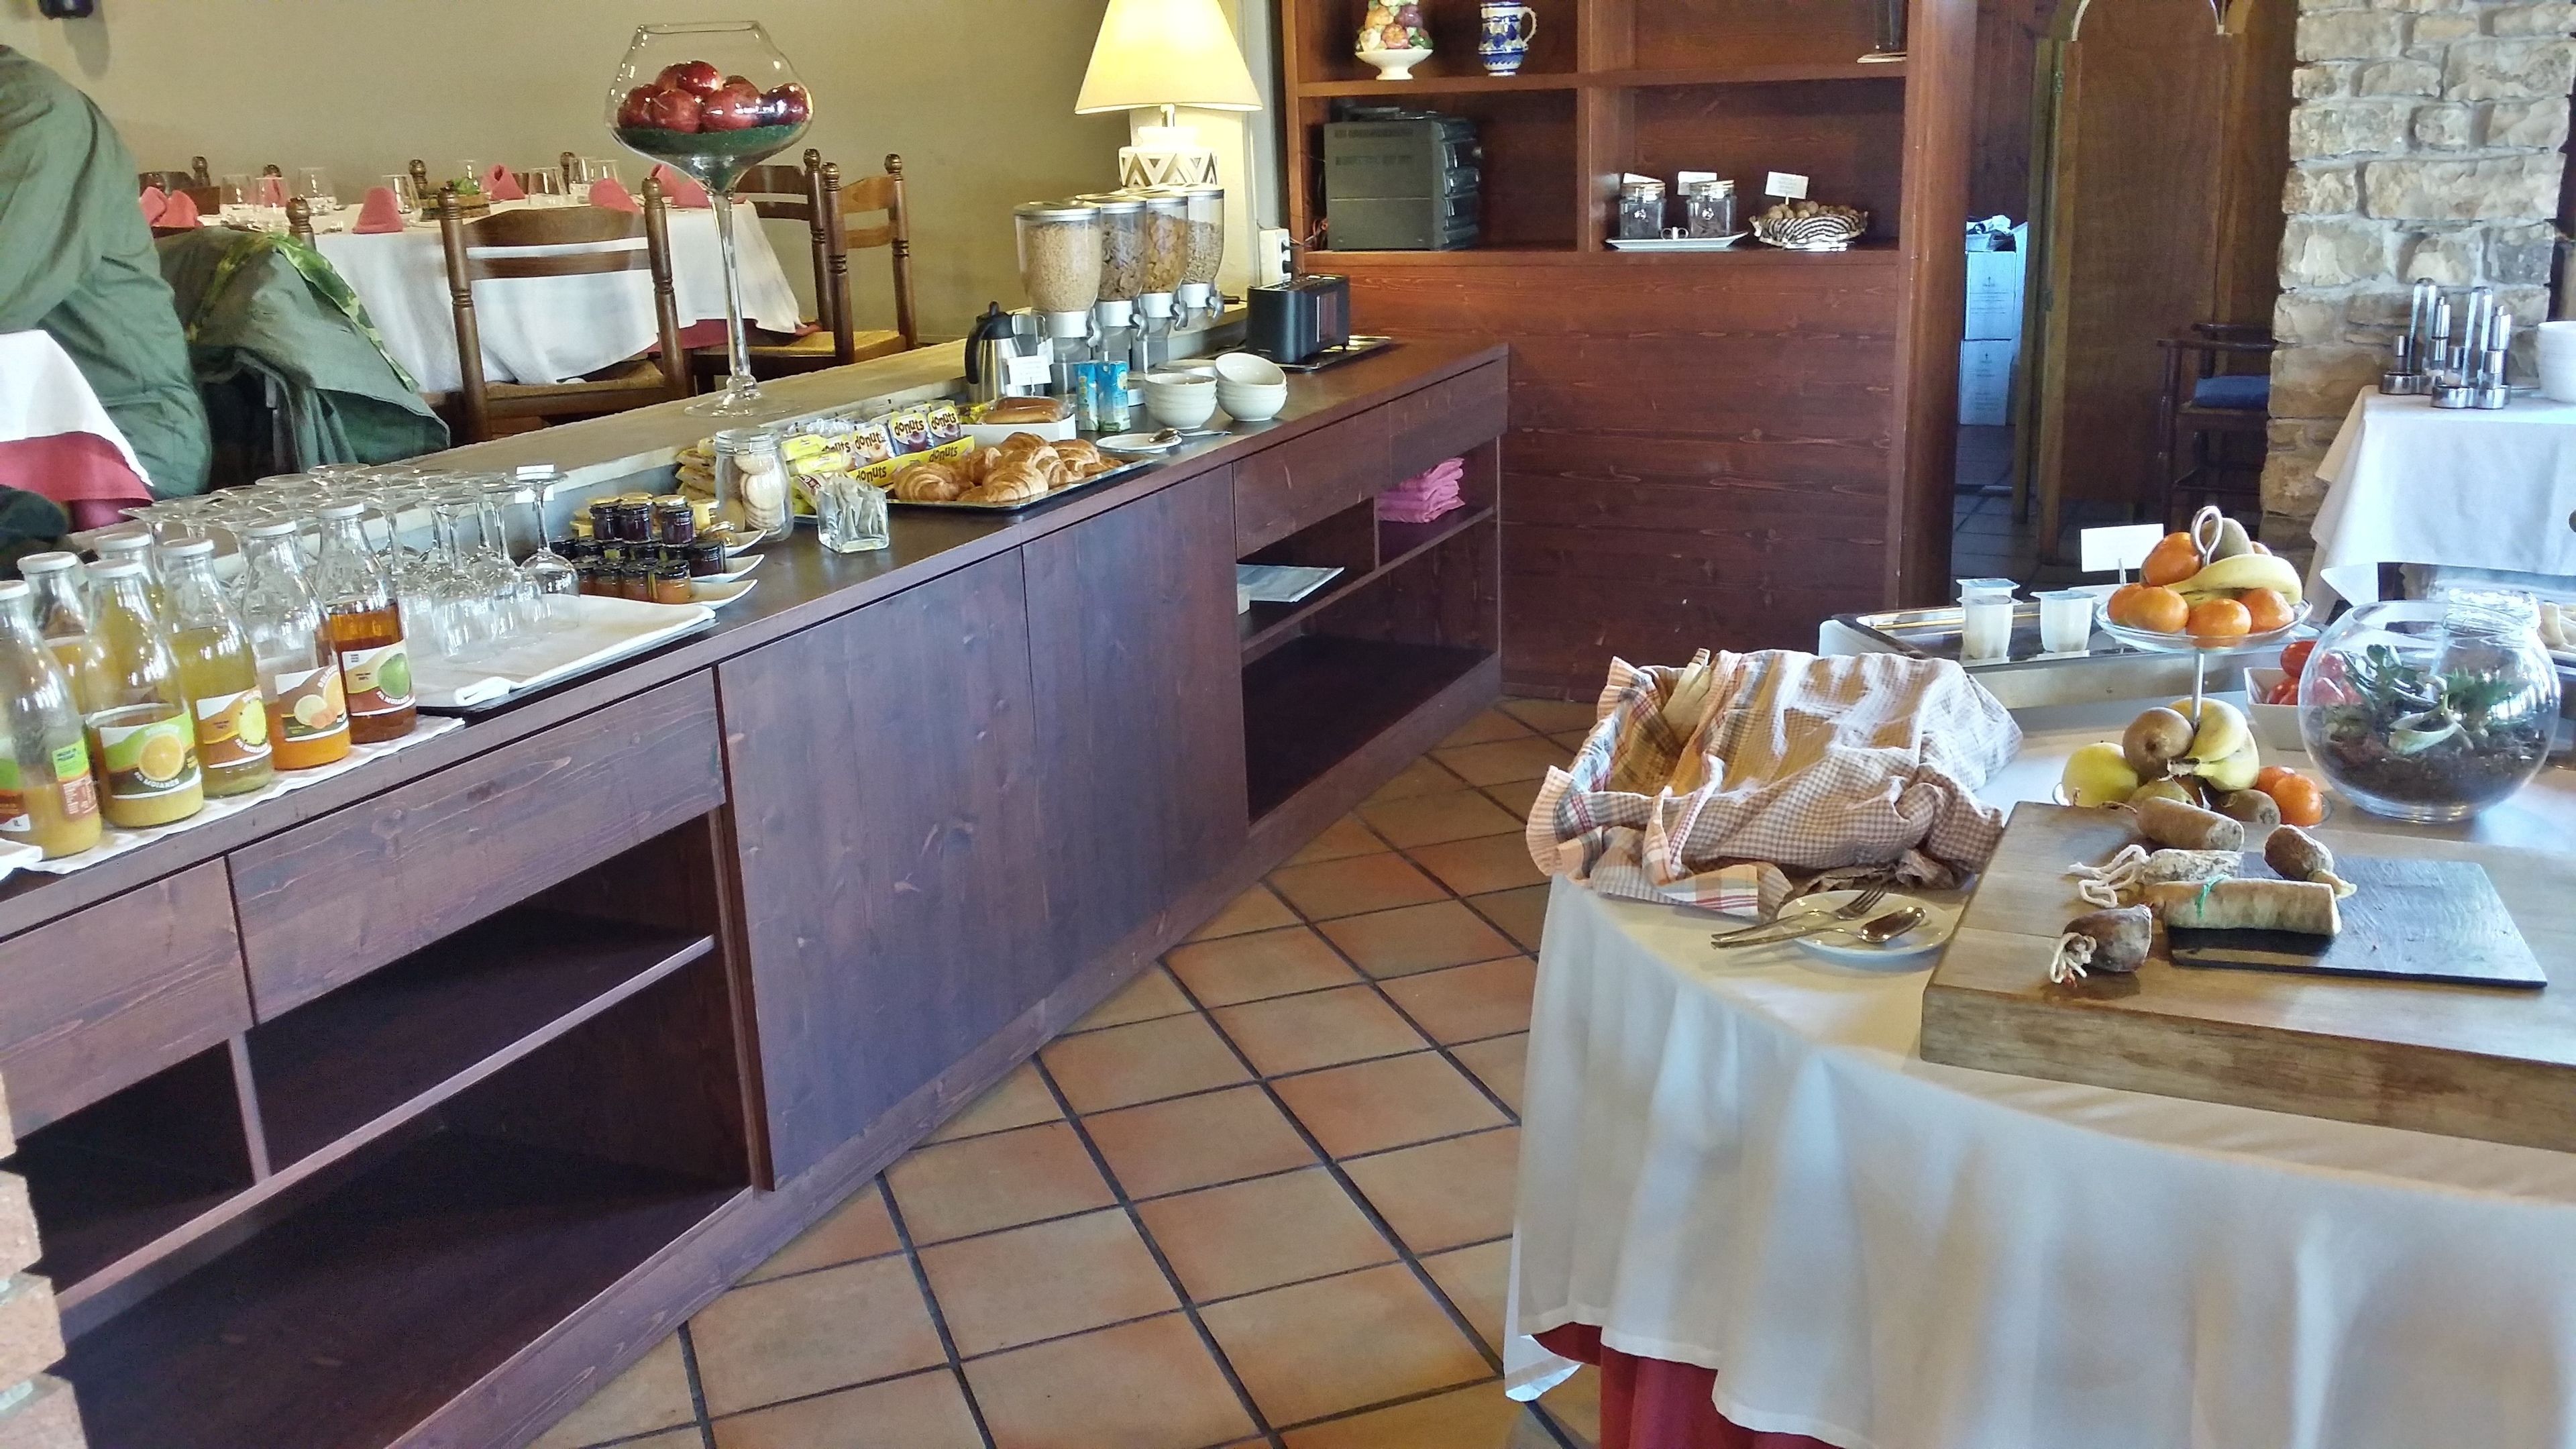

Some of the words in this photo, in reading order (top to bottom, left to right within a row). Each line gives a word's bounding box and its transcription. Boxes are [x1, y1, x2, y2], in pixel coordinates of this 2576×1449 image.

[894, 419, 924, 435] donuts
[931, 413, 956, 429] donuts
[929, 445, 958, 462] donuts
